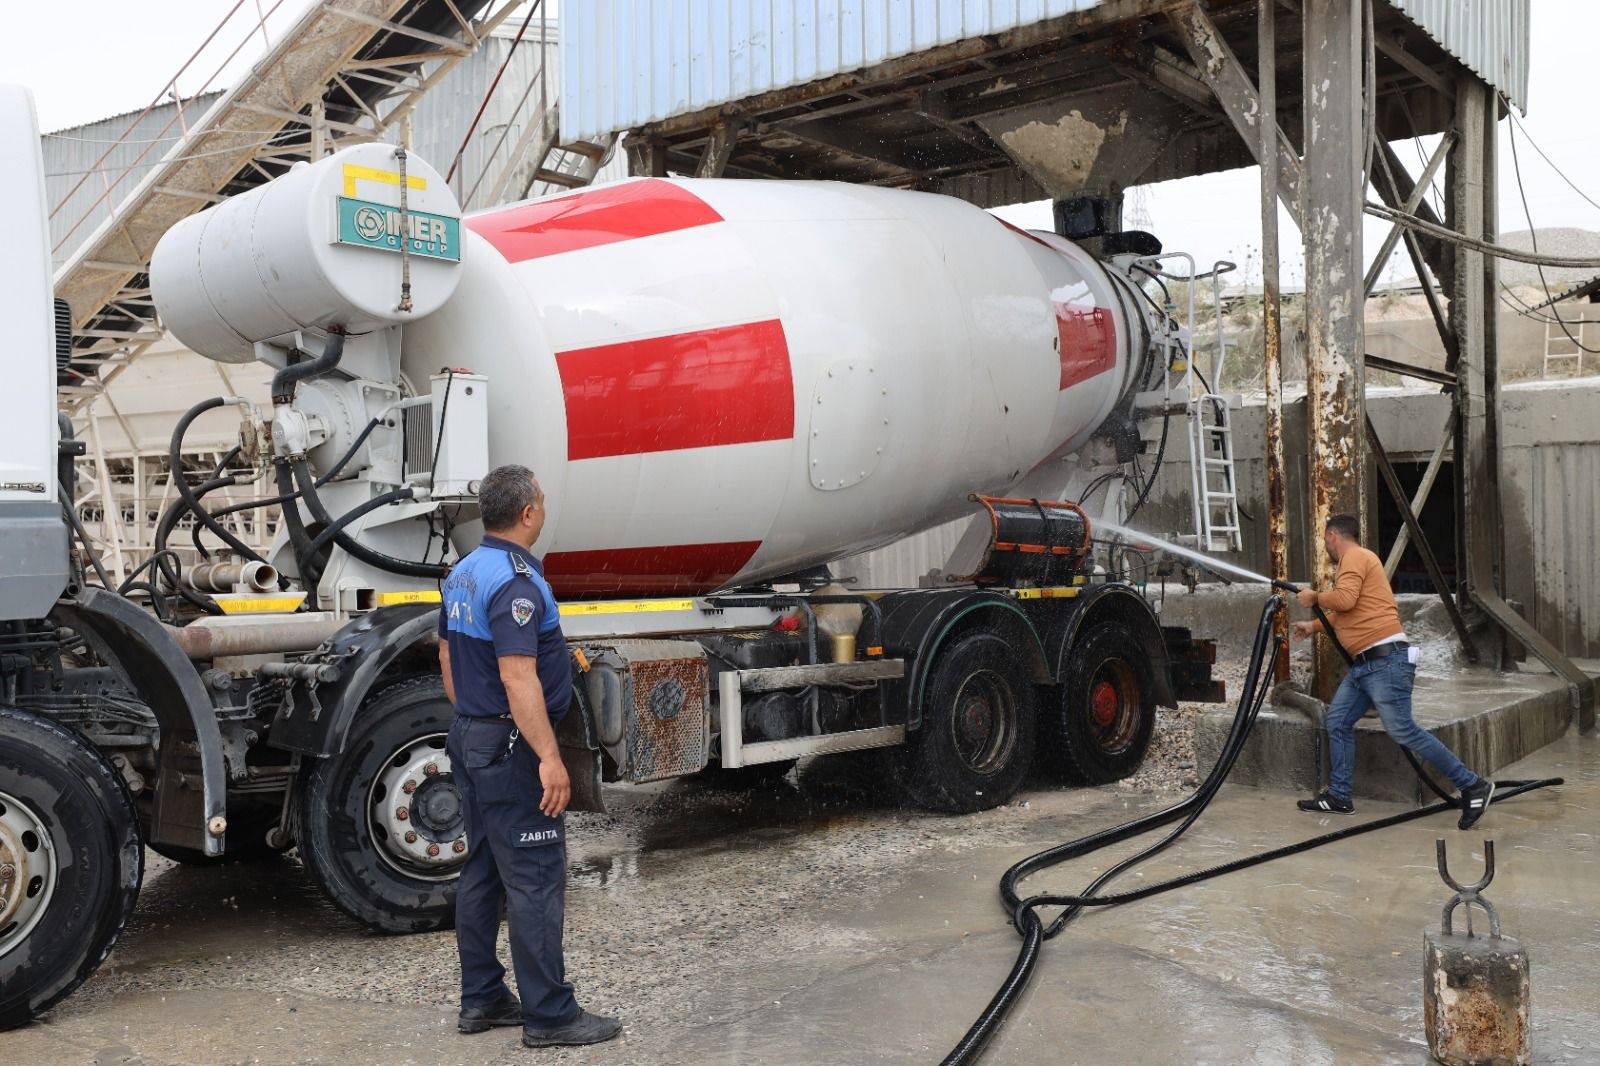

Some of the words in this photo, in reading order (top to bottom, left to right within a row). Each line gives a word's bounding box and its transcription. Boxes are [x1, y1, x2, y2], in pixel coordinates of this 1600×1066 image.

[386, 210, 447, 244] IMER
[387, 236, 448, 253] GOUP
[519, 829, 559, 842] ZABITA
